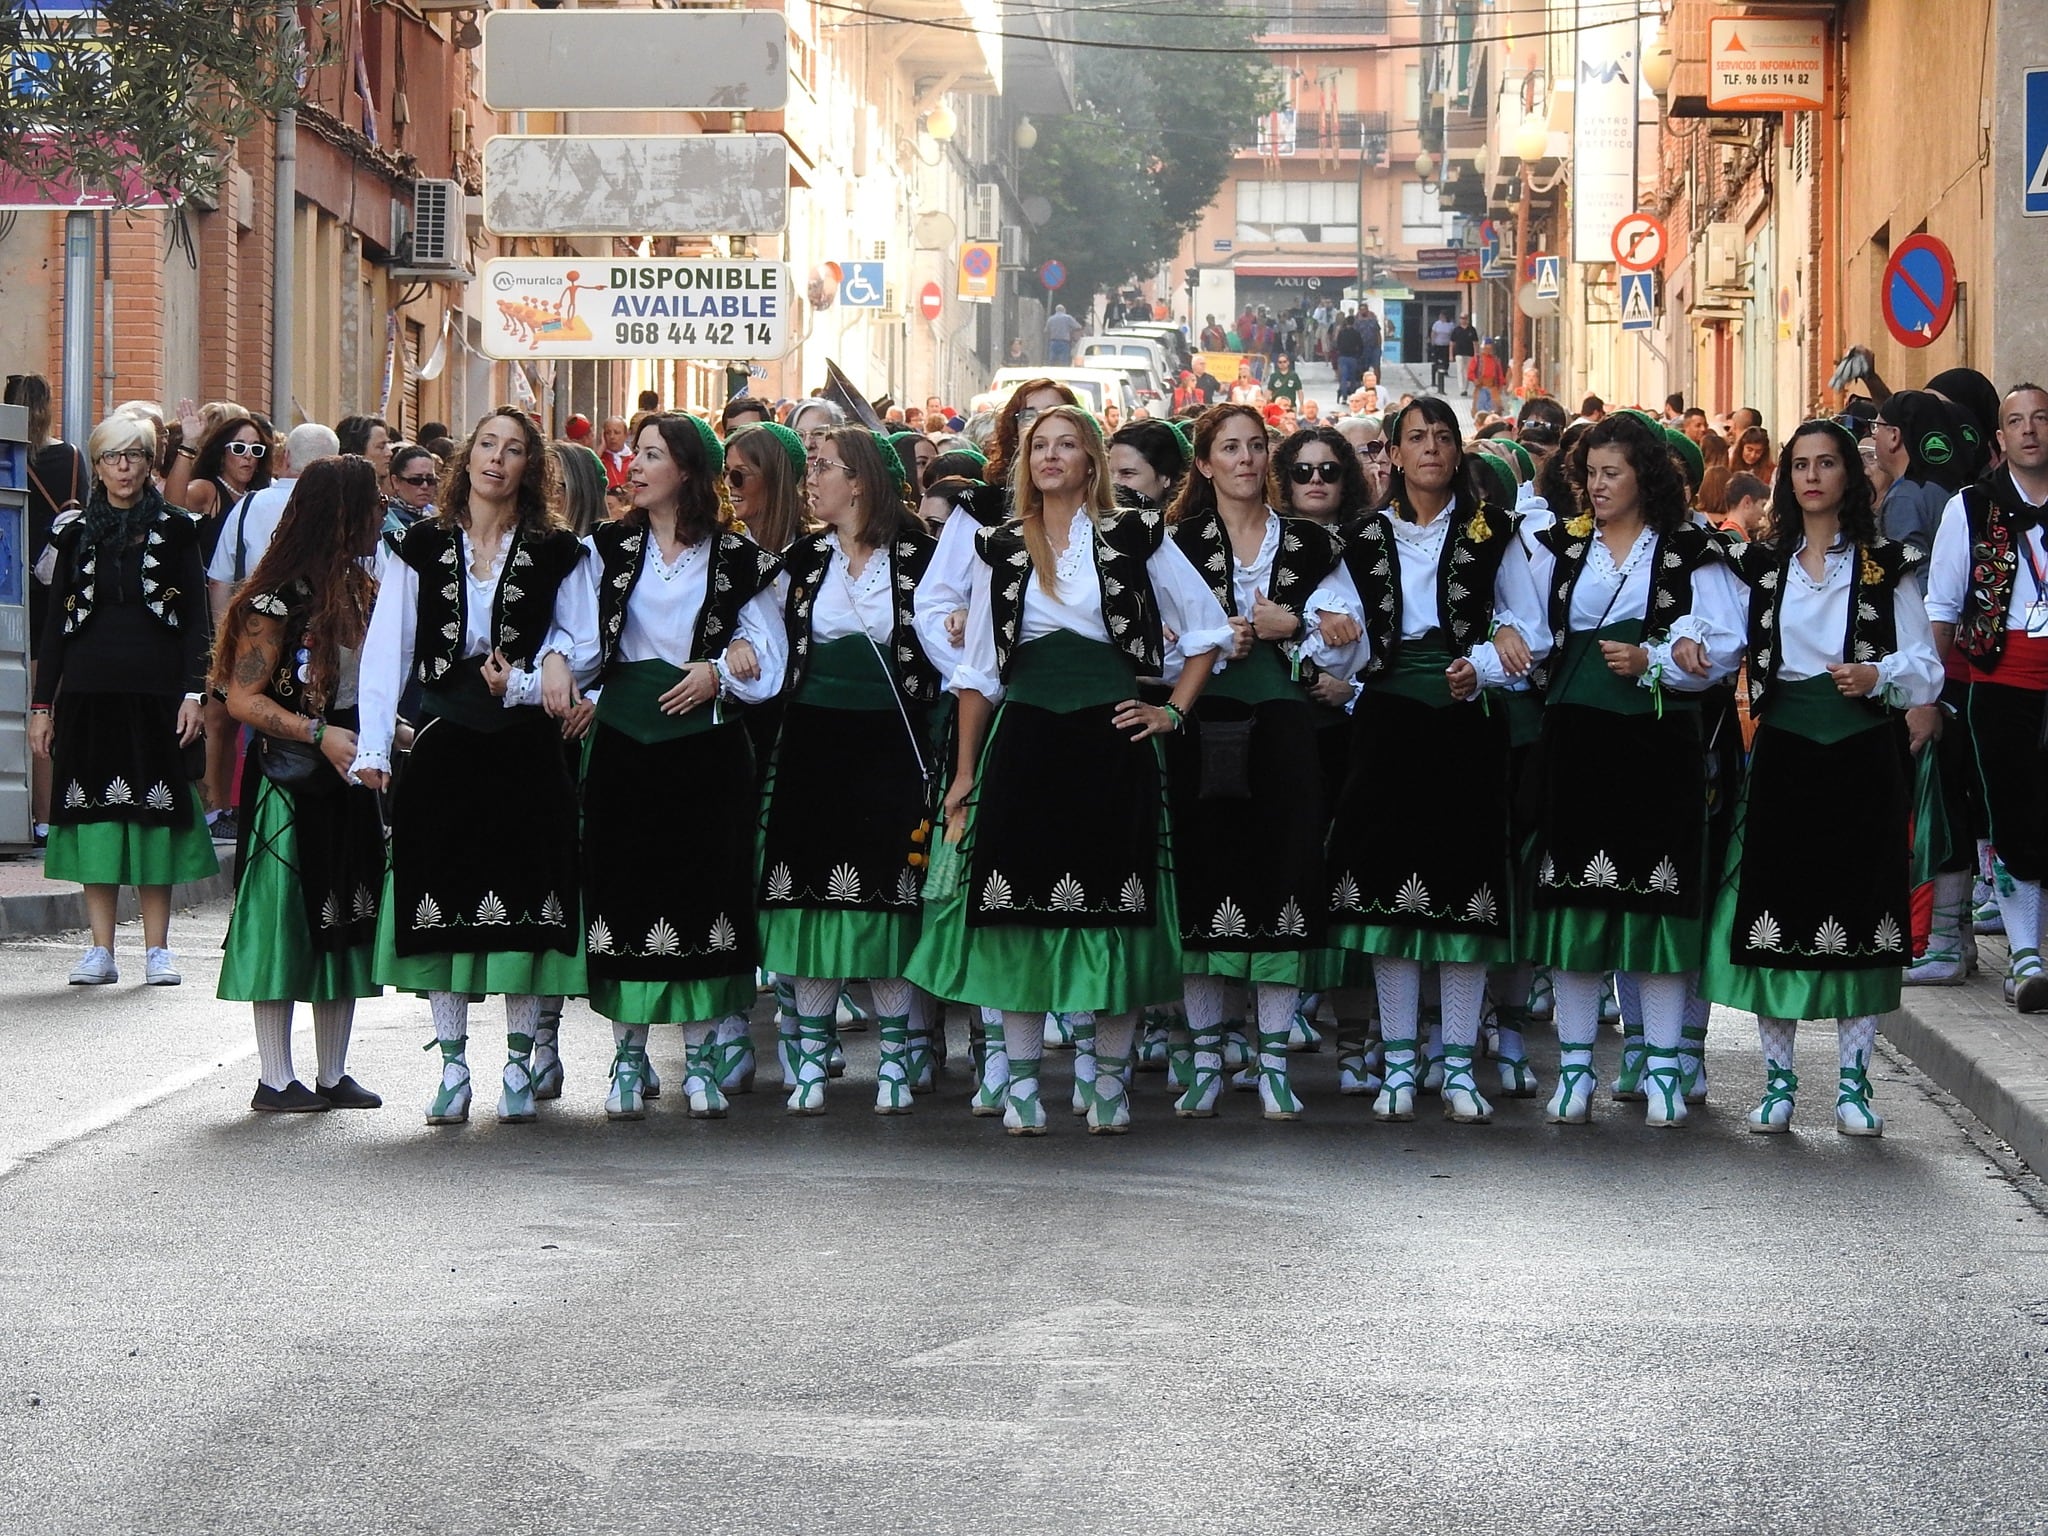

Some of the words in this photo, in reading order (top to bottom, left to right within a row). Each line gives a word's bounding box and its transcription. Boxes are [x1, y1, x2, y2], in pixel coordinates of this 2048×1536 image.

[1716, 61, 1756, 70] SERVICIOS
[1760, 59, 1820, 70] INFORMÁTICOS
[1723, 74, 1742, 85] TLF.
[1746, 74, 1757, 84] 96
[1761, 74, 1778, 84] 615
[1783, 74, 1793, 84] 14
[1798, 74, 1809, 84] 82
[516, 275, 563, 285] muralca
[610, 268, 777, 289] DISPONIBLE
[611, 295, 777, 317] AVAILABLE
[615, 323, 659, 344] 968
[667, 323, 697, 344] 44
[705, 323, 734, 344] 42
[744, 323, 772, 344] 14
